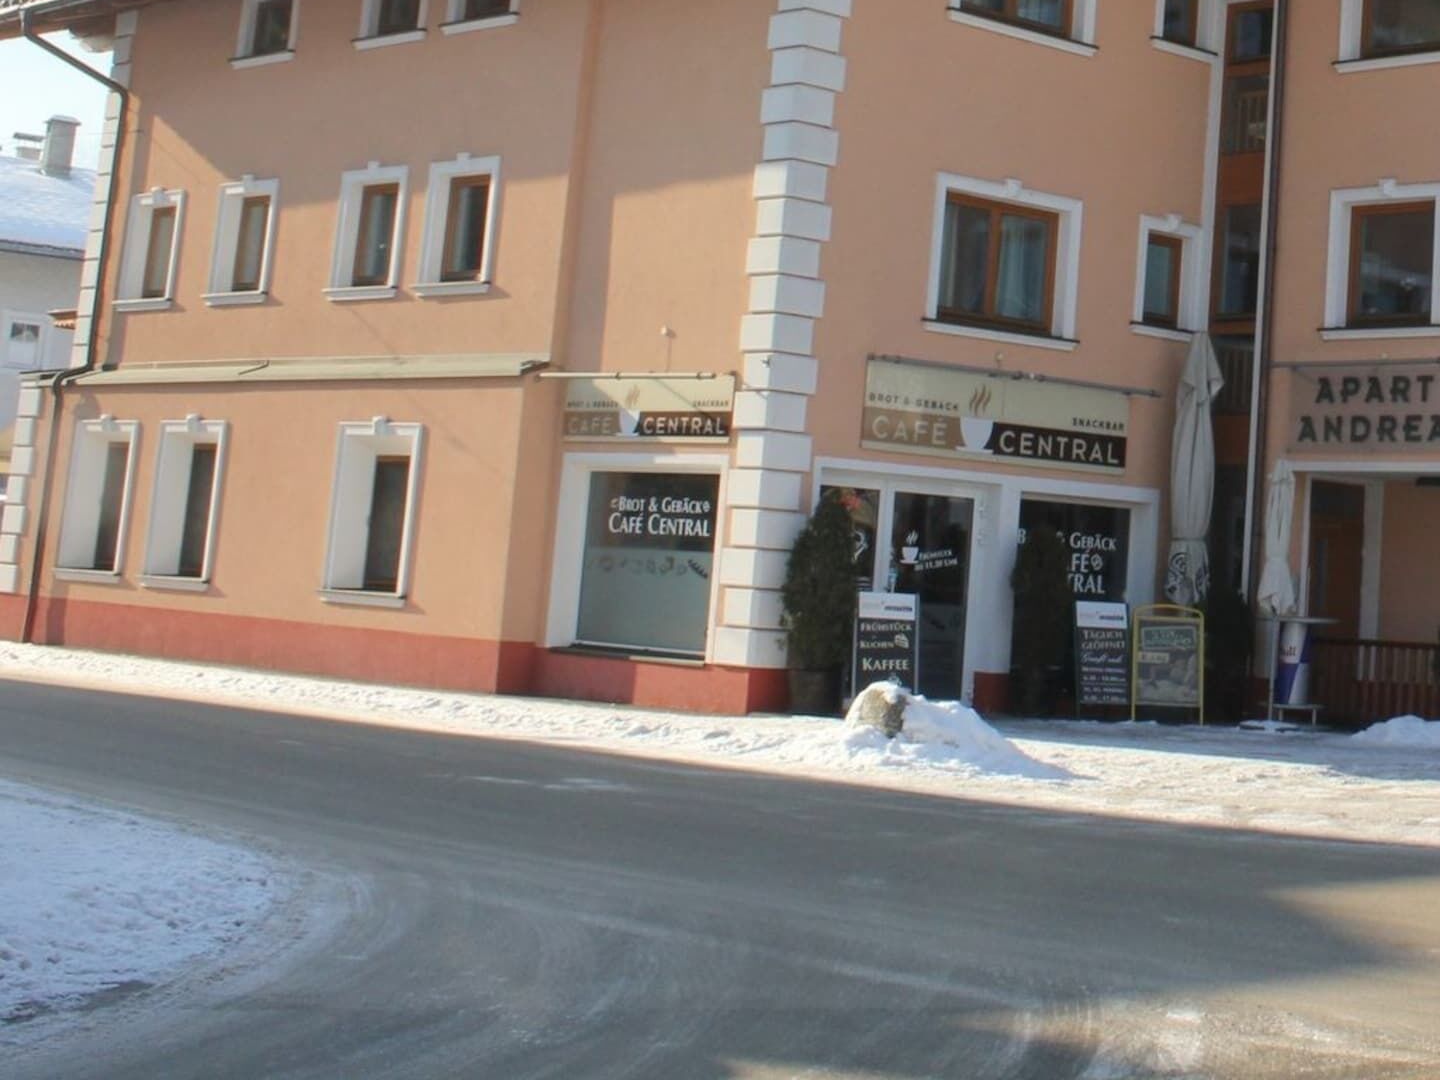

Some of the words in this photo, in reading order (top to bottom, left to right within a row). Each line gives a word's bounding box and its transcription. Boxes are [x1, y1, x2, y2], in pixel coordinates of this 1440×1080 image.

[1315, 375, 1434, 404] APART
[643, 417, 725, 435] CENTRAL
[1072, 417, 1124, 431] SNACKBAR
[872, 414, 948, 445] CAFÉ
[1000, 430, 1119, 464] CENTRAL
[619, 496, 645, 512] BROT
[648, 497, 658, 513] &
[662, 497, 702, 514] GEBÄCK
[608, 512, 643, 534] CAFÉ
[648, 514, 710, 537] CENTRAL
[1069, 531, 1117, 551] GEBÄCK
[1071, 548, 1090, 573] FÉ
[861, 623, 912, 632] FRÜHSTÜCK
[862, 658, 909, 671] KAFFEE
